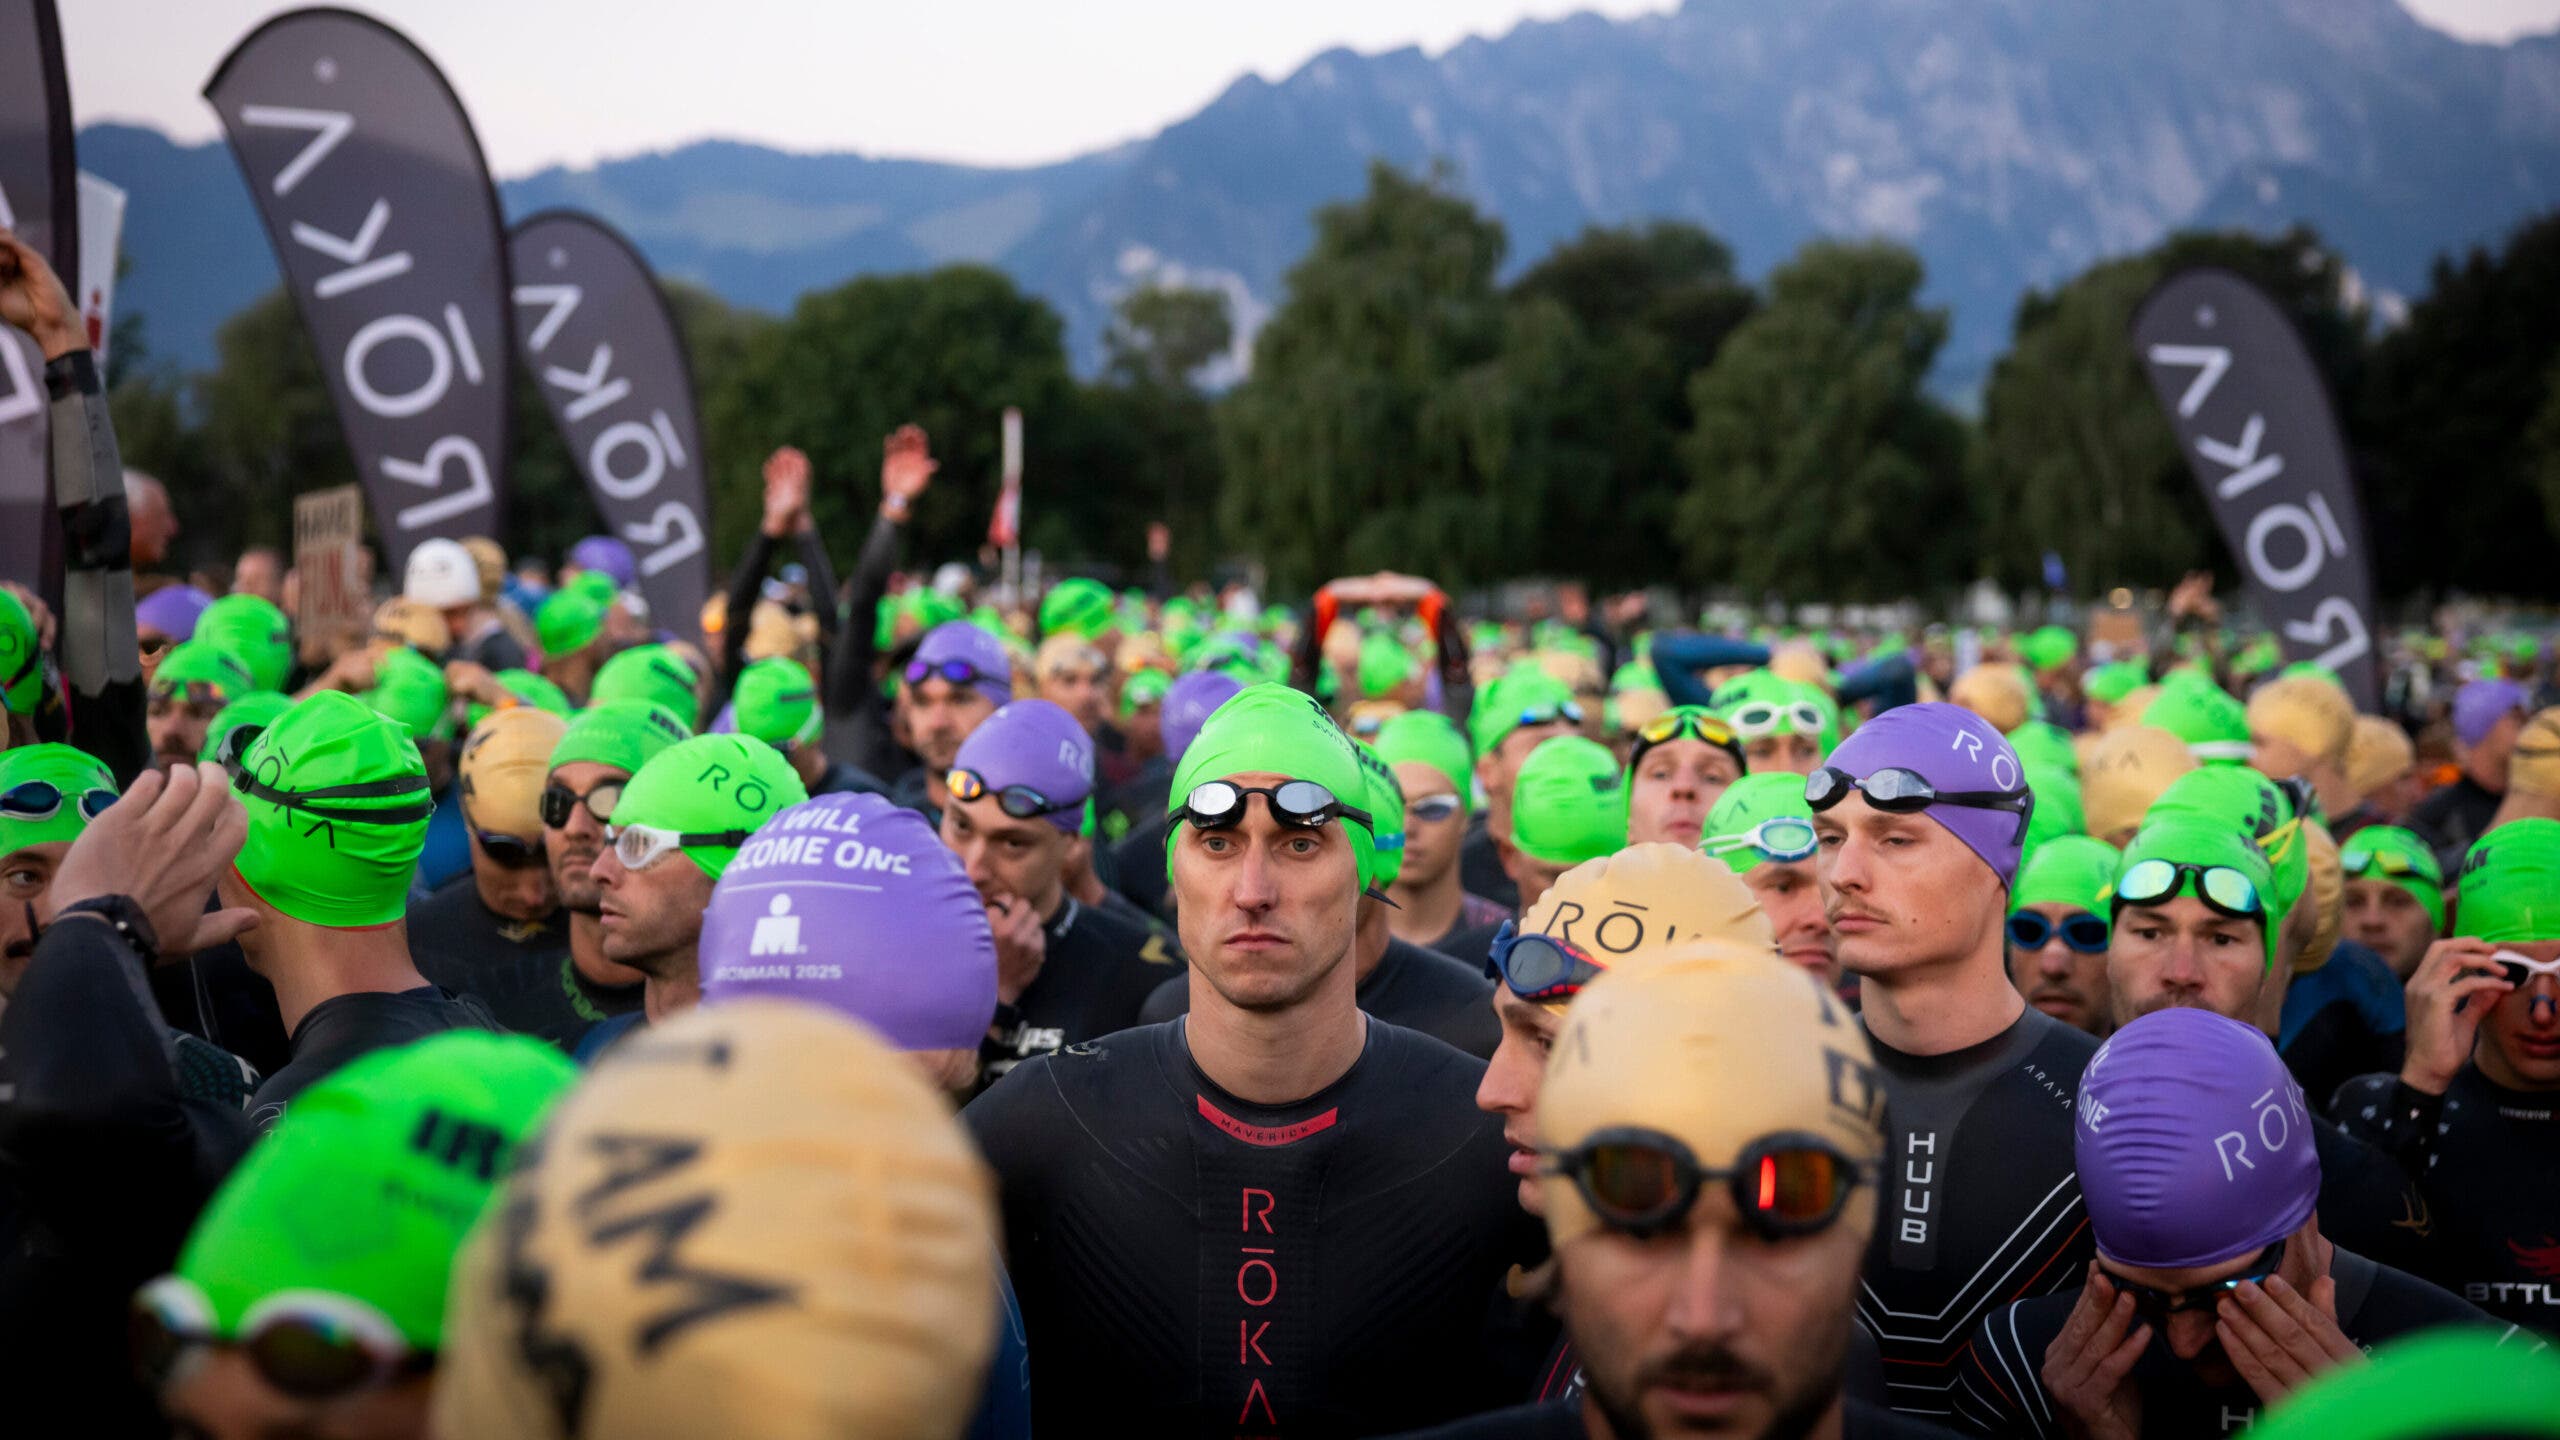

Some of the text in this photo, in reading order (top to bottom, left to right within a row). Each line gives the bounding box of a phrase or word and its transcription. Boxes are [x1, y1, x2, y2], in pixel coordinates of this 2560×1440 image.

[782, 807, 862, 835] WILL
[728, 836, 913, 876] COME ONE
[794, 964, 843, 981] 2025
[1220, 1118, 1310, 1142] MAVERICK
[1900, 1132, 1936, 1244] HUUB
